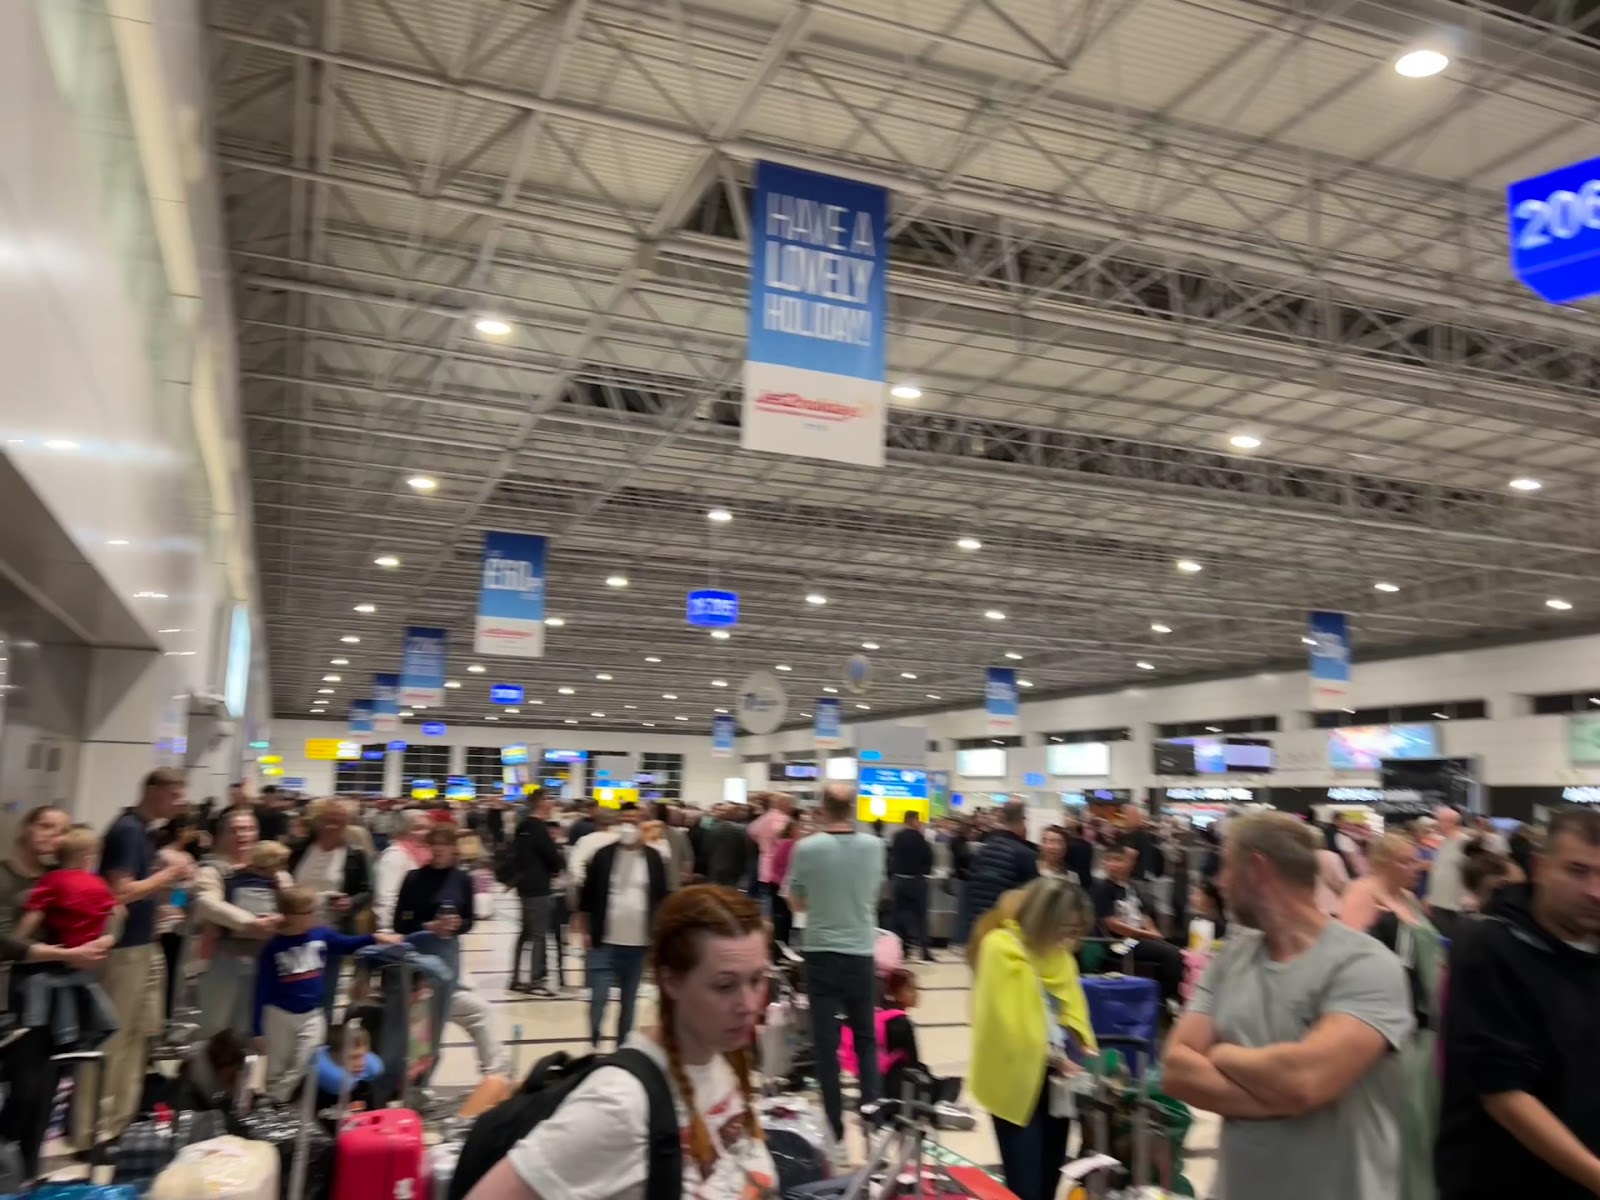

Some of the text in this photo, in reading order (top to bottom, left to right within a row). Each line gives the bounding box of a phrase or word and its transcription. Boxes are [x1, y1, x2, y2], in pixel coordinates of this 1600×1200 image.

[766, 192, 876, 256] HAVE A
[765, 241, 875, 304] LOVELY
